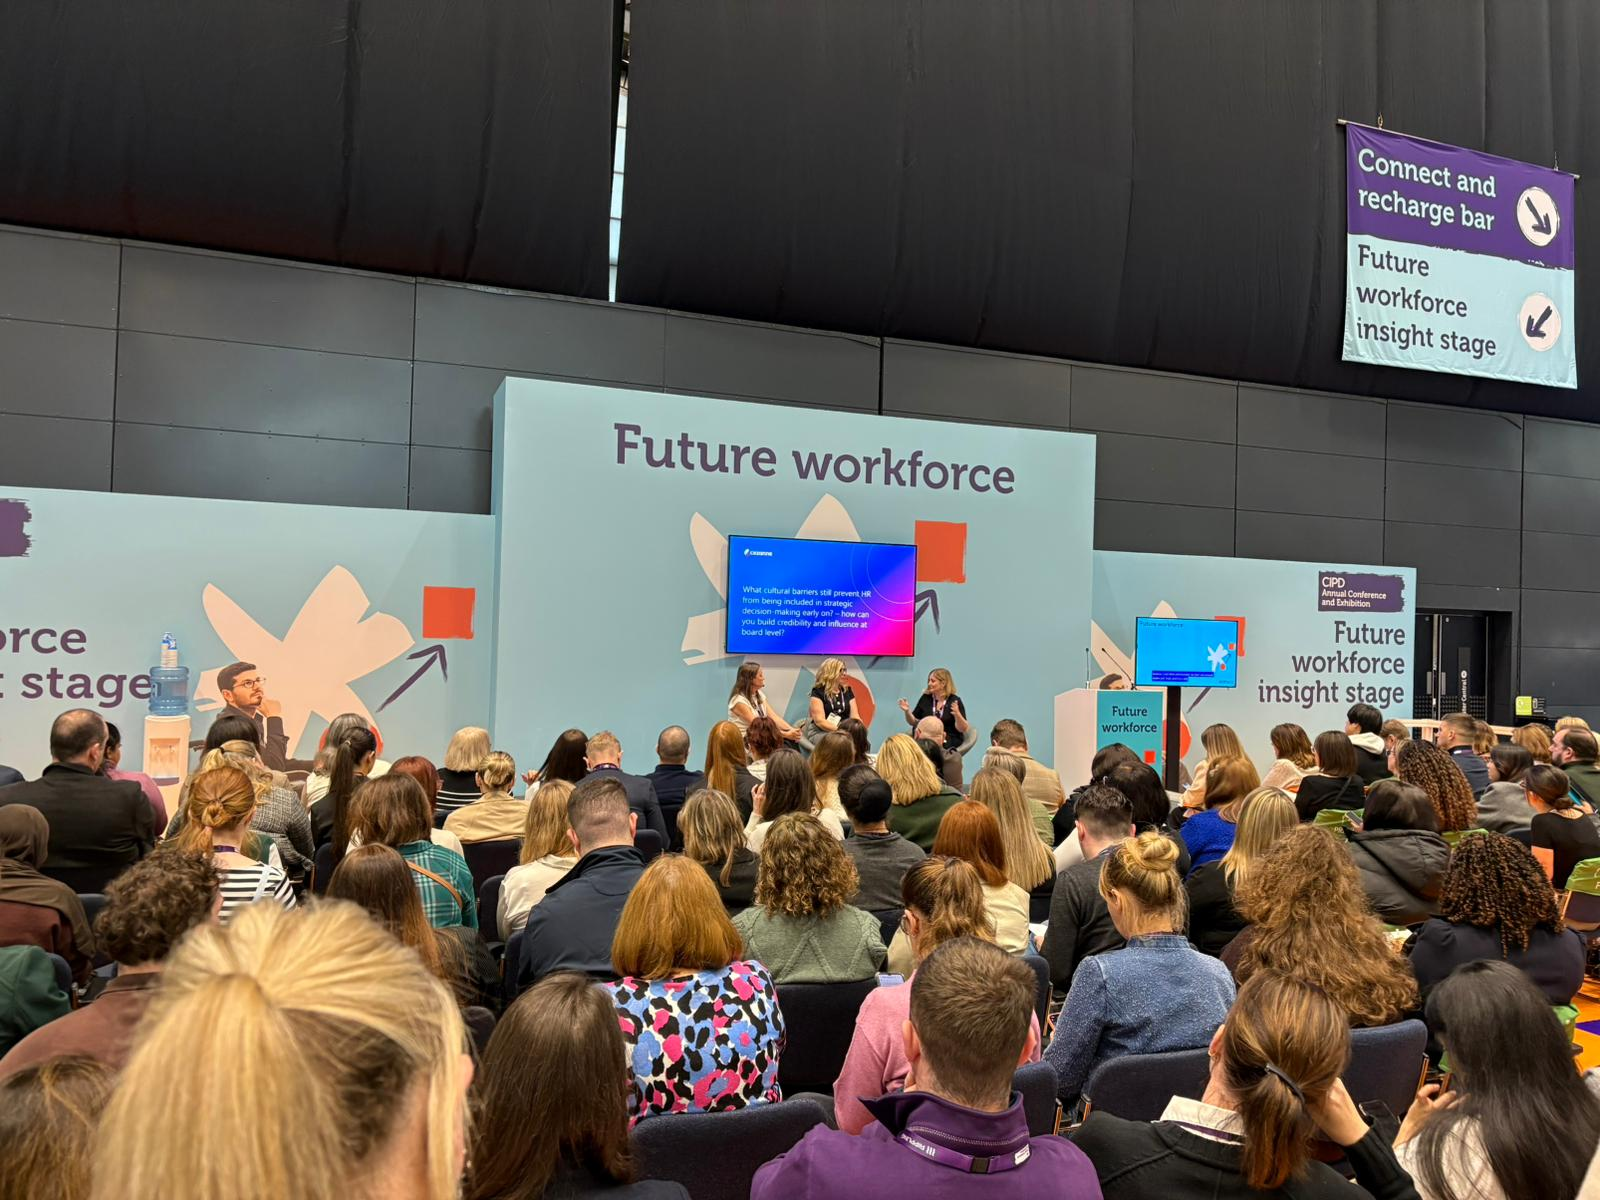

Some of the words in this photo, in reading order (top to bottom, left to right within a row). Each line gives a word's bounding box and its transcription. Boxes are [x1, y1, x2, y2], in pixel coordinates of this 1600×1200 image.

[1358, 148, 1451, 189] Connect
[1457, 174, 1496, 198] and
[1358, 188, 1455, 226] recharge
[1461, 204, 1495, 231] bar
[1358, 244, 1430, 277] Future
[1356, 286, 1468, 317] workforce
[1357, 316, 1434, 350] insight
[1440, 330, 1497, 360] stage
[614, 422, 777, 477] Future
[792, 448, 1015, 494] workforce
[742, 585, 762, 594] What
[1322, 576, 1346, 588] CIPD
[1322, 589, 1346, 598] Annual
[1348, 590, 1386, 599] Conference
[742, 608, 801, 617] decision-making
[802, 609, 819, 618] early
[762, 597, 782, 606] being
[824, 600, 853, 608] strategic
[1336, 599, 1371, 607] Exhibition
[777, 619, 812, 628] credibility
[1334, 620, 1406, 645] Future
[0, 627, 87, 654] rce
[1292, 650, 1405, 674] workforce
[20, 667, 152, 708] stage
[1258, 679, 1338, 709] insight
[1346, 682, 1404, 709] stage
[1112, 706, 1148, 716] Future
[1102, 722, 1157, 733] workforce
